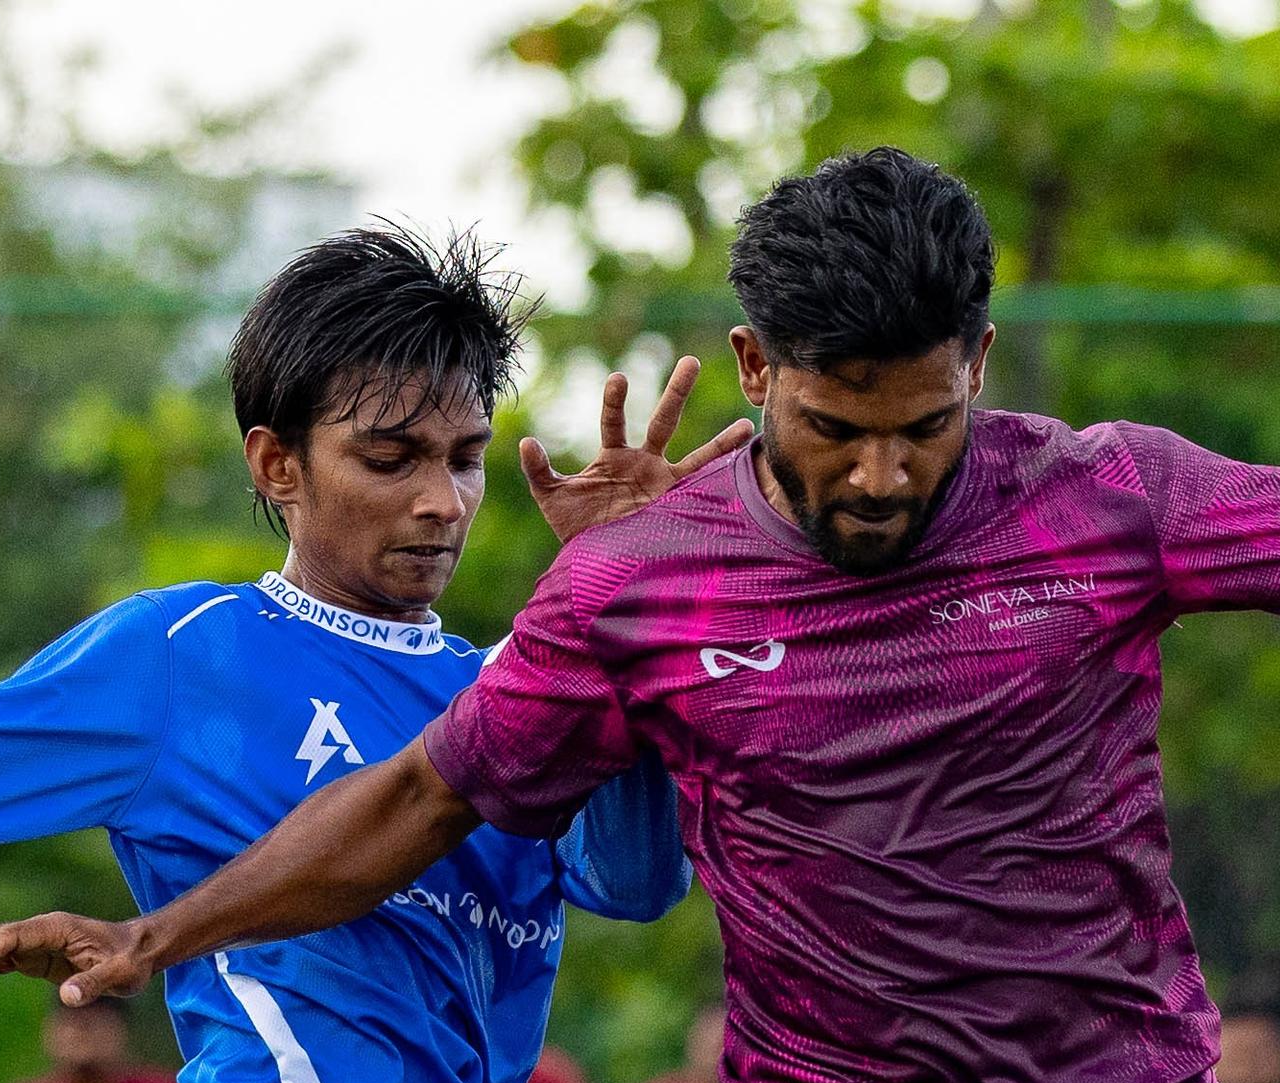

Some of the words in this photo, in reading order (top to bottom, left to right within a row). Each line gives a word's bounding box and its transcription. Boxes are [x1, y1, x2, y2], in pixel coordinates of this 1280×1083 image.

[929, 587, 1035, 625] SONEVA
[1042, 573, 1096, 601] JANI
[988, 608, 1050, 632] MALDIVES
